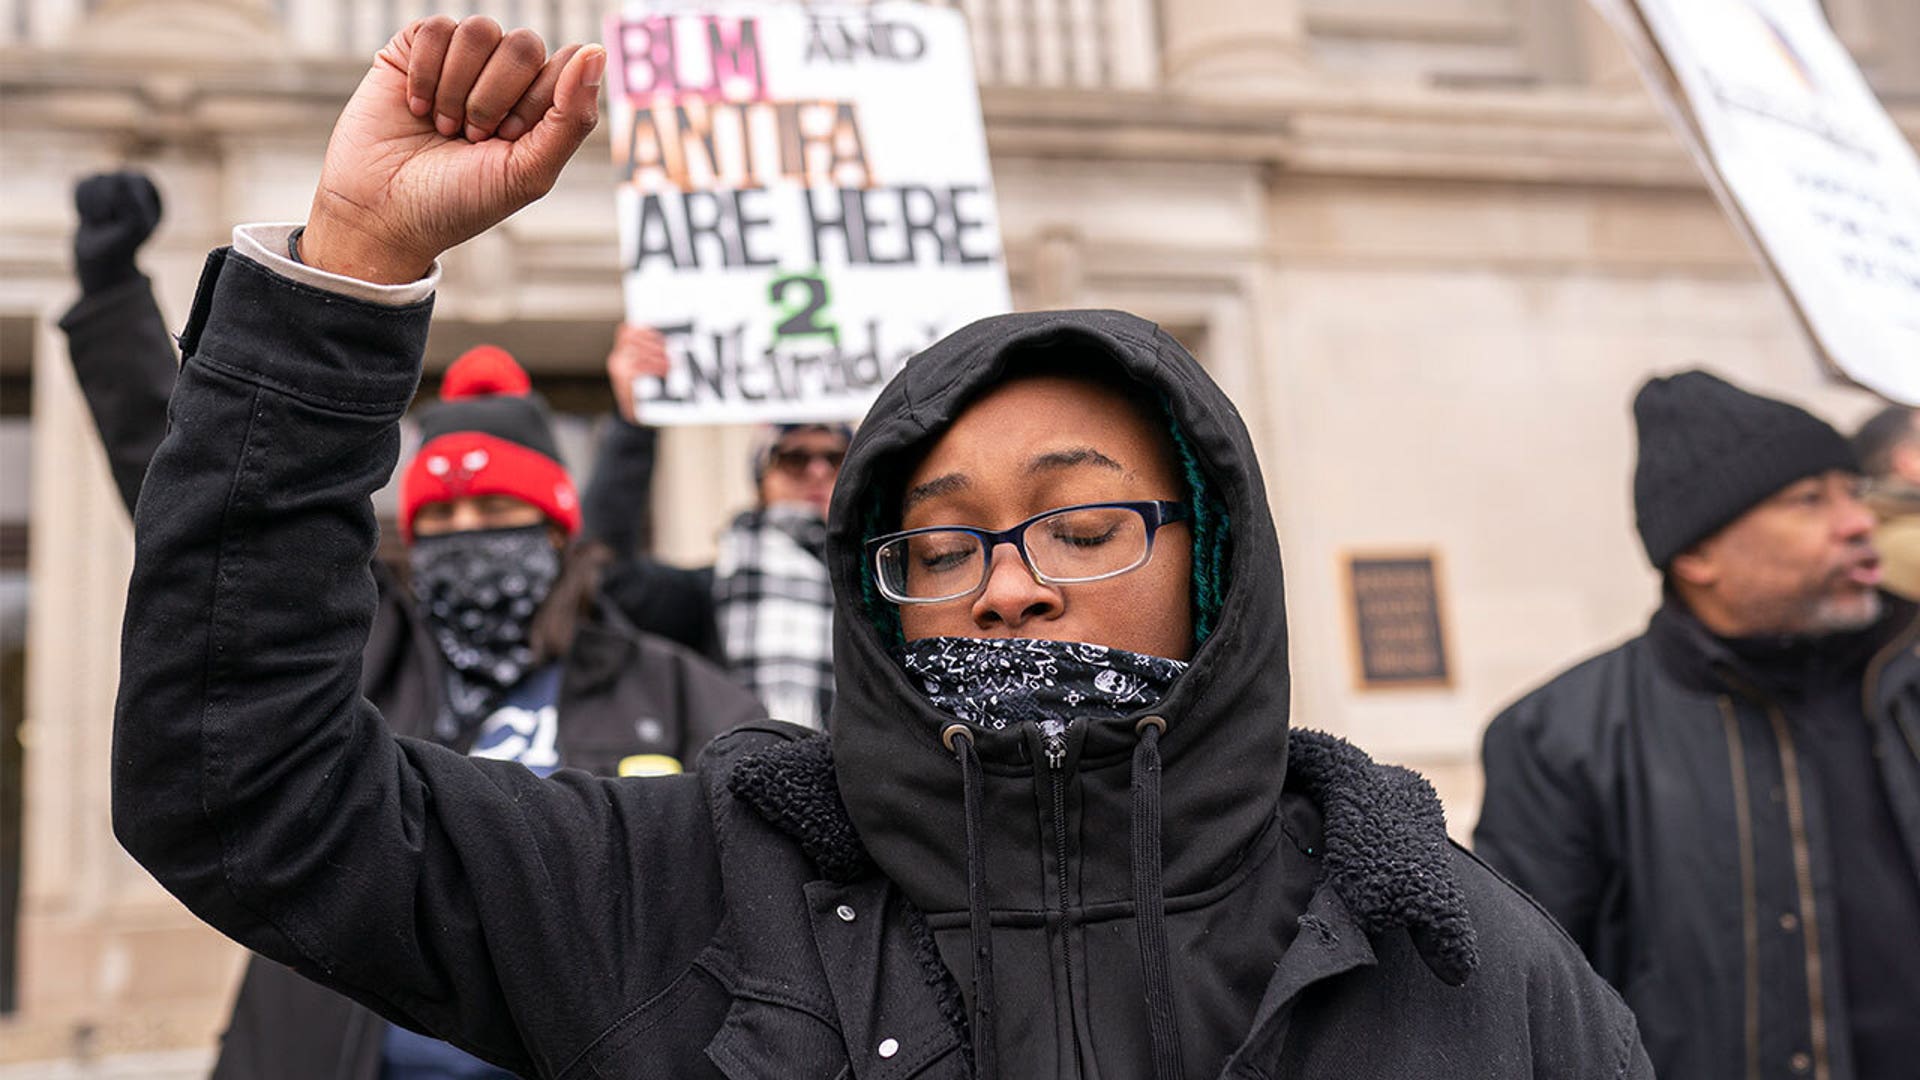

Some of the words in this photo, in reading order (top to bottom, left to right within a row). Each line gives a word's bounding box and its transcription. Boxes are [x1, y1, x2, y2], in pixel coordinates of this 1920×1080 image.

[617, 15, 766, 97] BLM
[804, 16, 927, 64] AND
[618, 101, 877, 189] ANTIFA
[634, 184, 778, 269] ARE
[802, 184, 992, 268] HERE
[768, 272, 842, 343] 2
